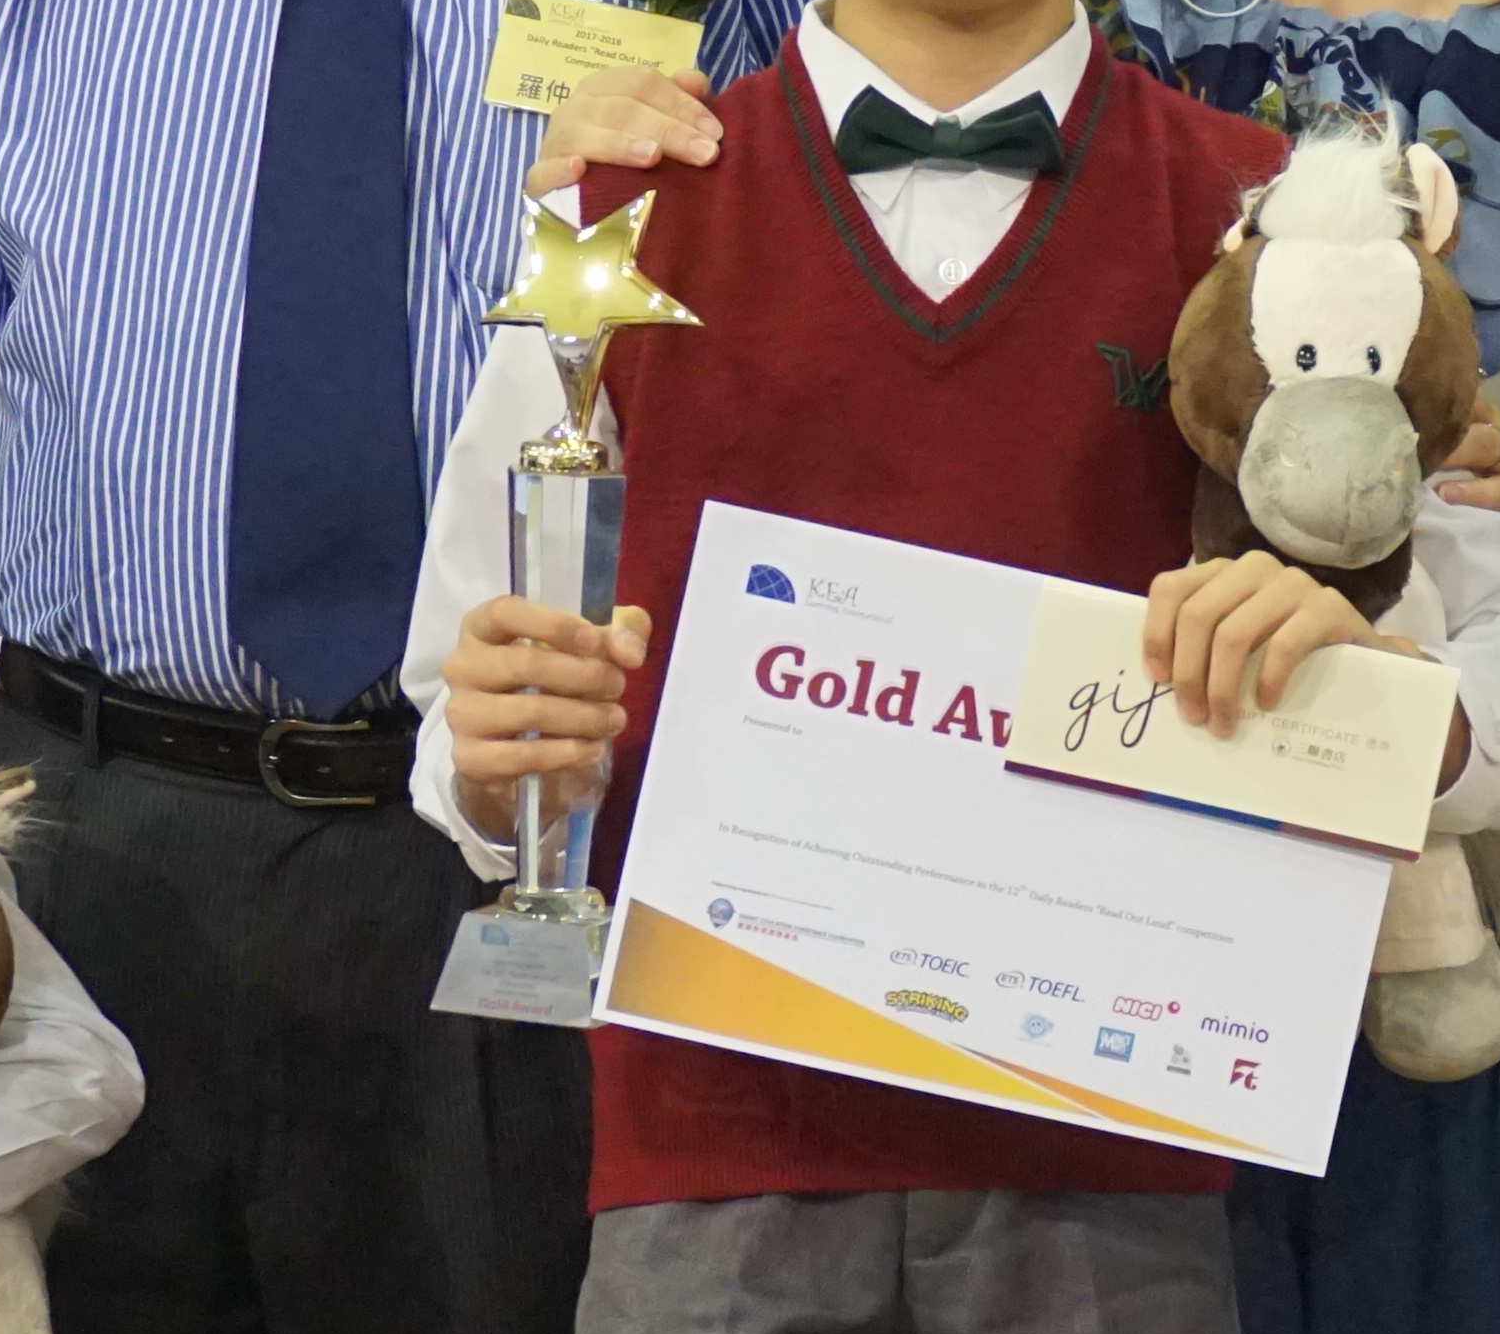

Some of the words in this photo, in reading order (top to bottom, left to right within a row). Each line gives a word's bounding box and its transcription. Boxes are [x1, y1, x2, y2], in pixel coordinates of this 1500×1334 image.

[527, 33, 550, 47] Daily
[552, 39, 587, 53] Readers
[619, 52, 636, 64] Out
[575, 30, 622, 46] 2017-2018
[565, 55, 612, 71] Competiti
[755, 645, 921, 727] Gold
[919, 953, 970, 977] TOEIC
[1028, 976, 1081, 1003] TOEFL
[885, 989, 969, 1024] STRIKING
[1112, 996, 1162, 1021] NICI
[1200, 1016, 1269, 1044] mimio
